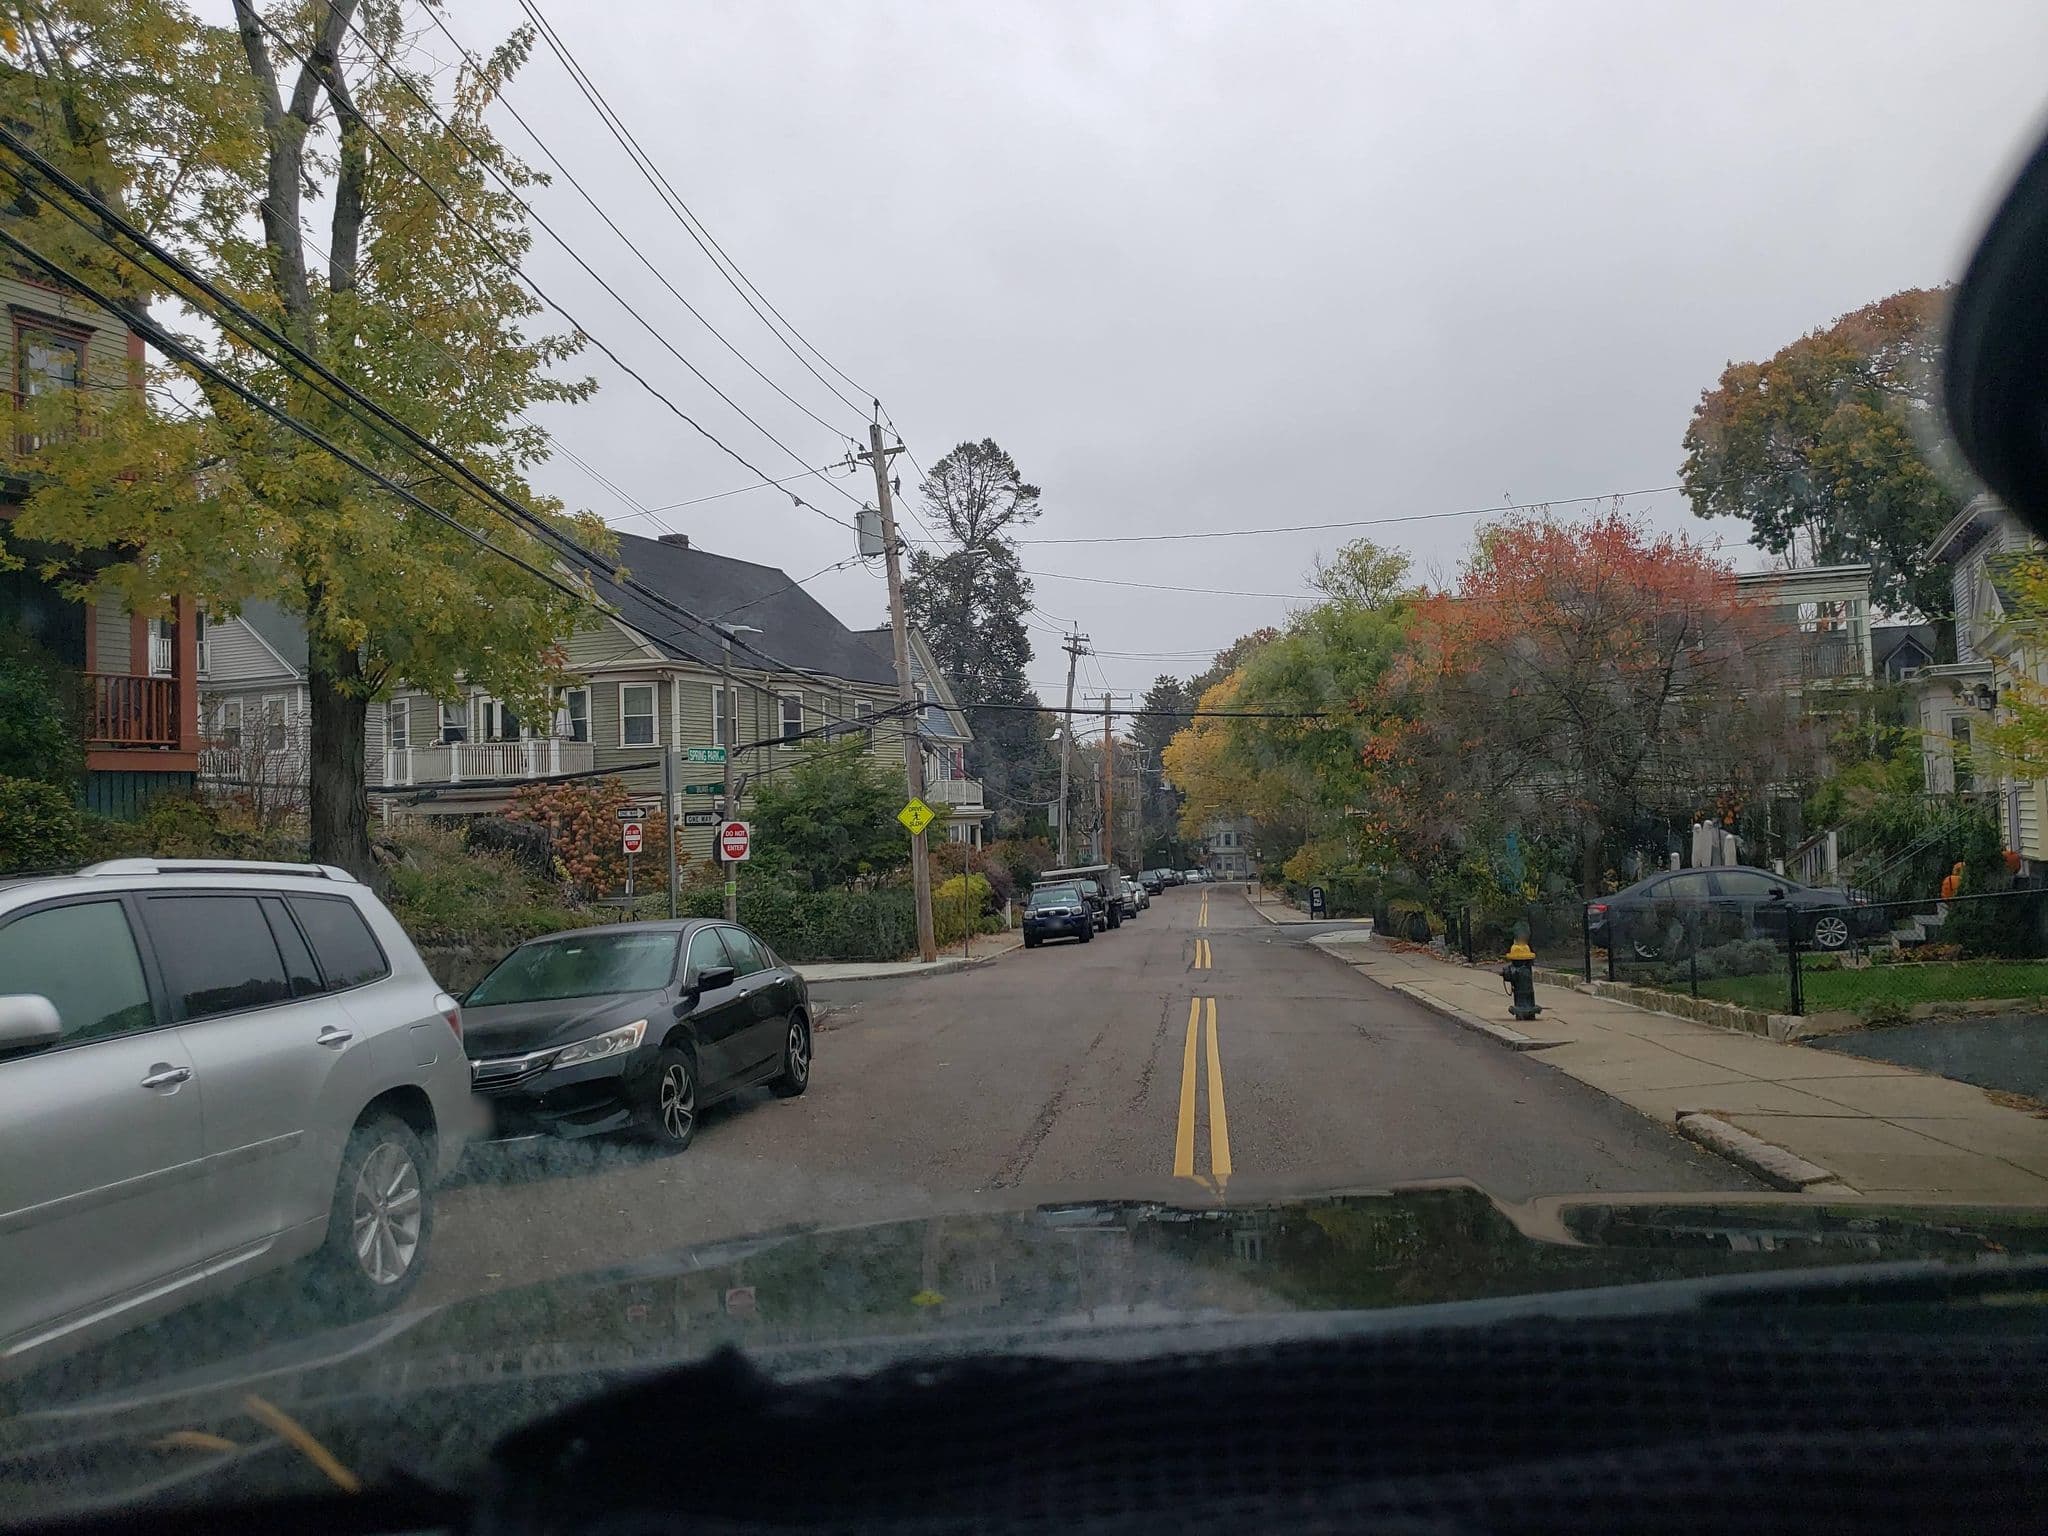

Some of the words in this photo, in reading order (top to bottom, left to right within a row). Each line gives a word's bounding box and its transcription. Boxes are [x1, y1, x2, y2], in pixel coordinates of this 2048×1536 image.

[689, 749, 707, 761] SPRING
[707, 750, 720, 761] PARK
[688, 815, 699, 823] ONE
[701, 815, 712, 823] WAY
